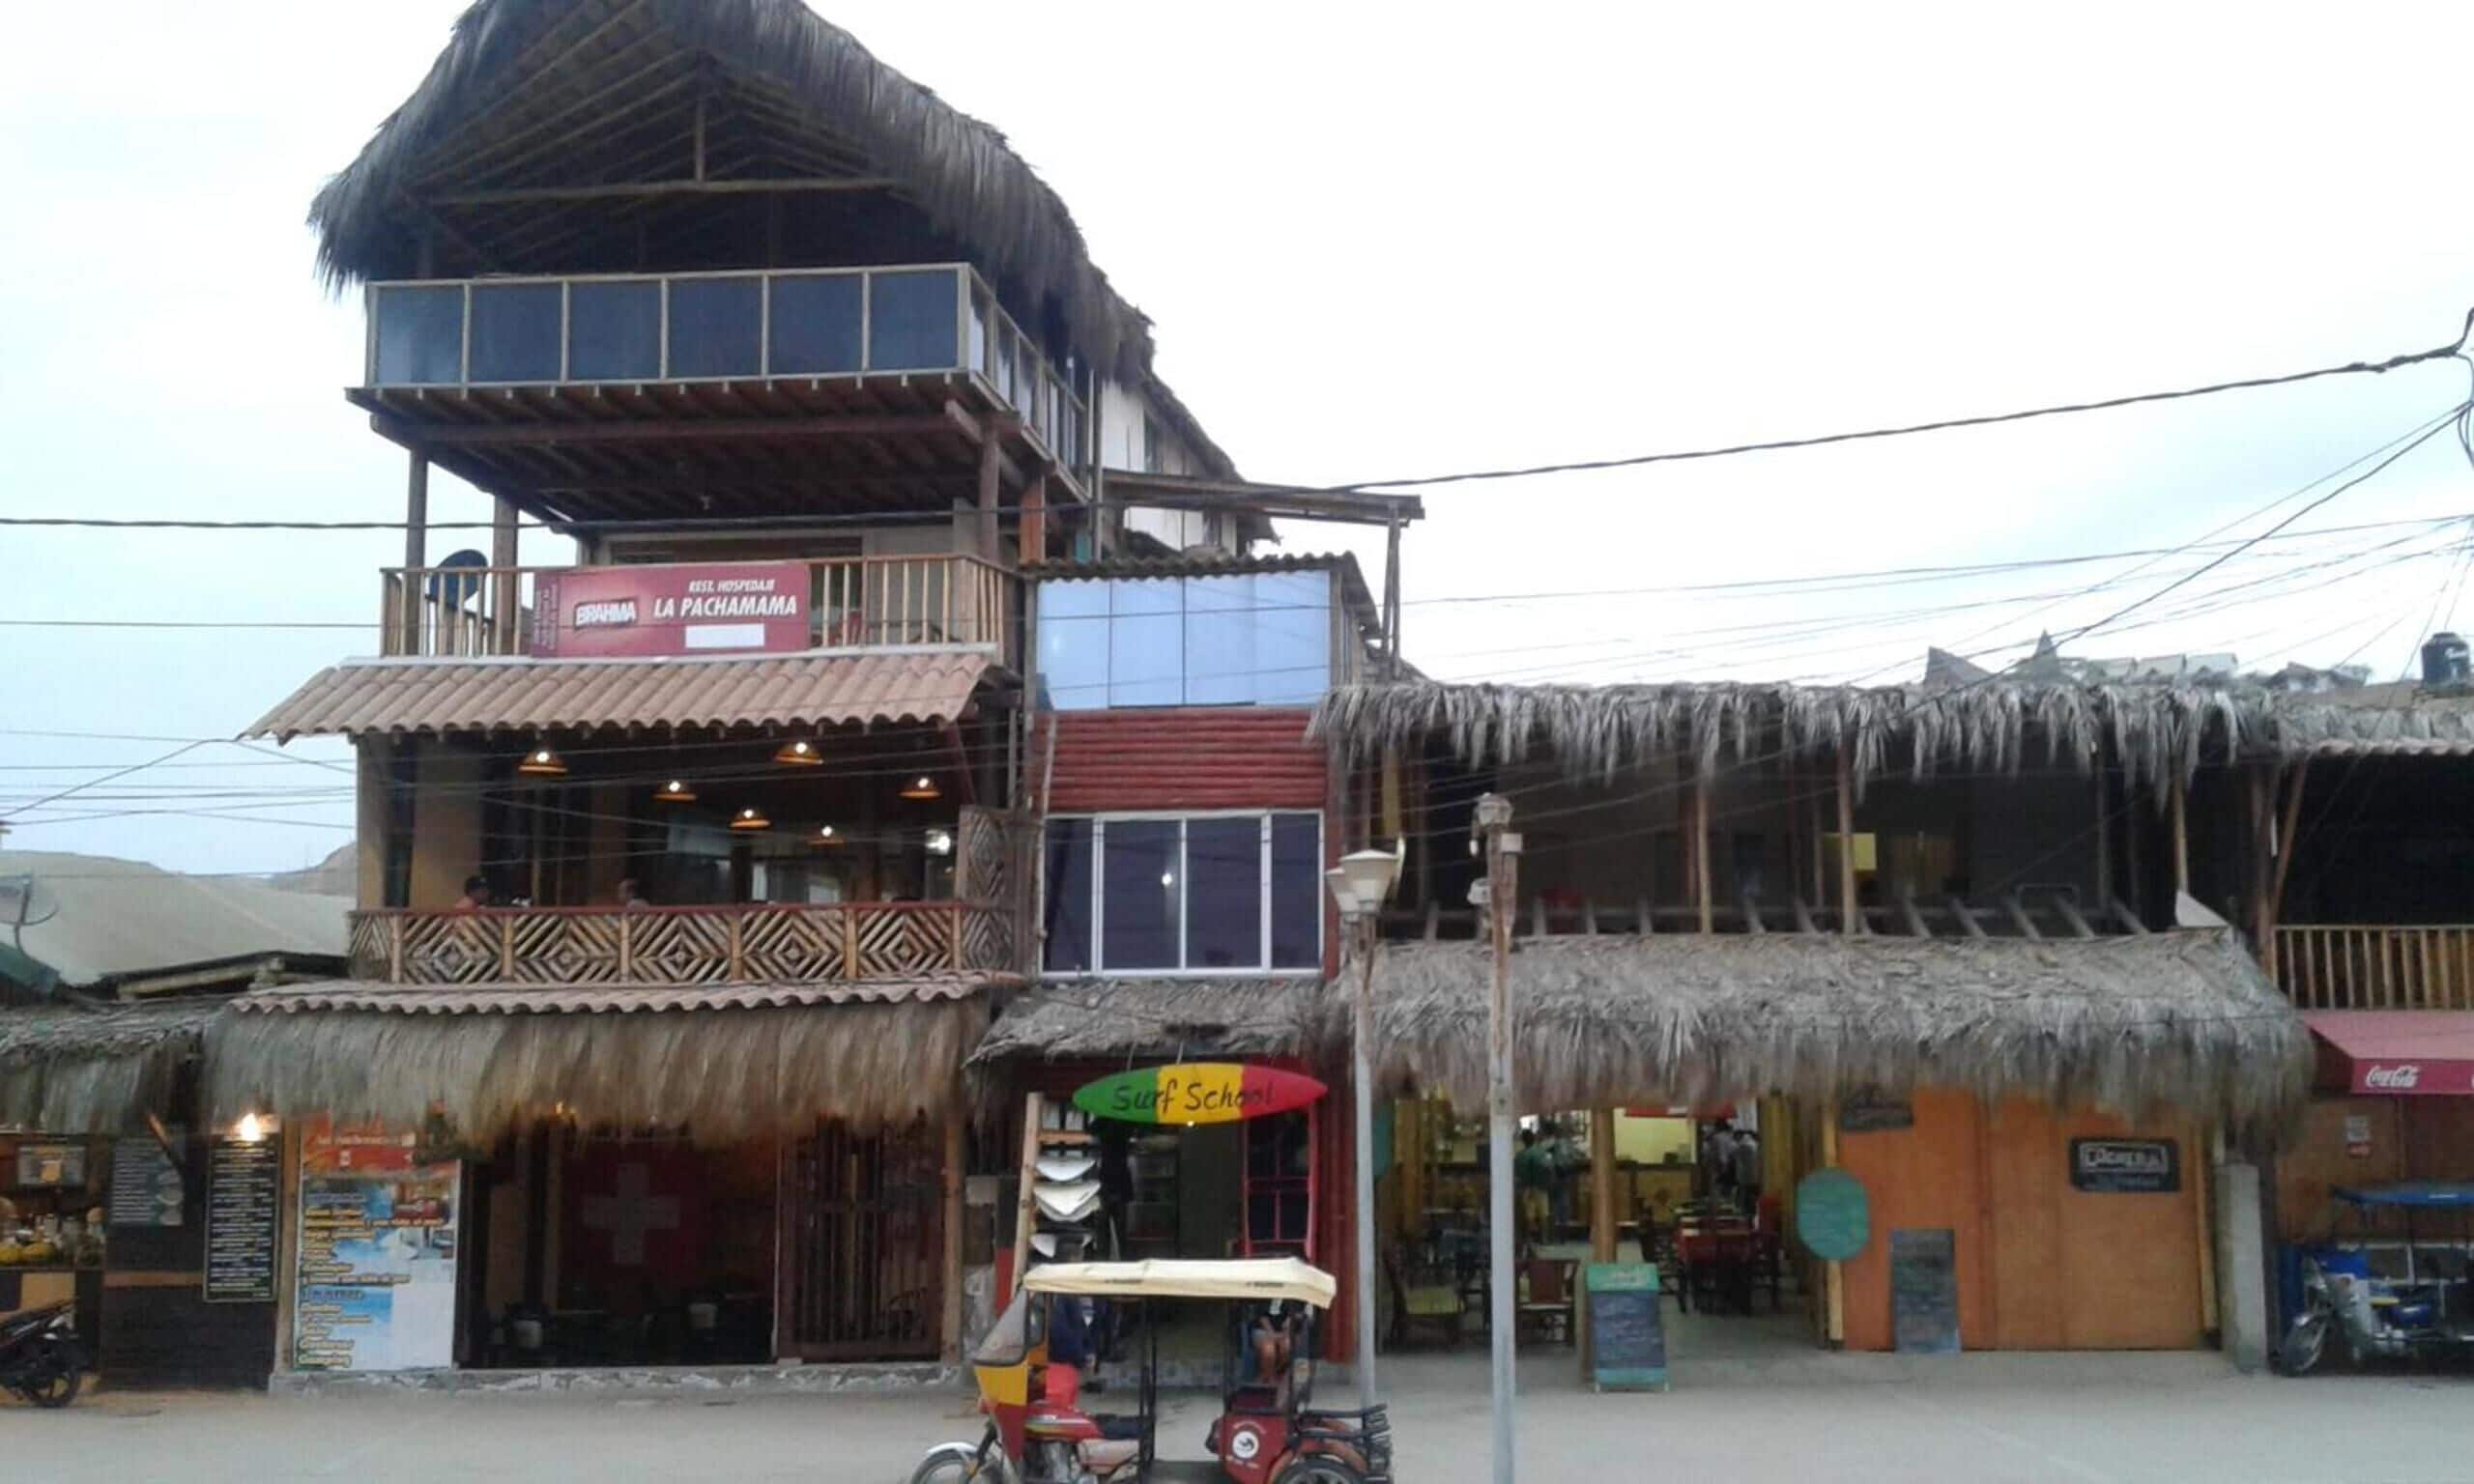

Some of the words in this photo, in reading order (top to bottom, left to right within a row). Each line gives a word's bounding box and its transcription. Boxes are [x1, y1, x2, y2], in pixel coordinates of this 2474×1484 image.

[653, 597, 675, 617] LA
[680, 595, 797, 617] PACHAMAMA
[1111, 1078, 1178, 1114] Surf
[1184, 1081, 1274, 1112] School
